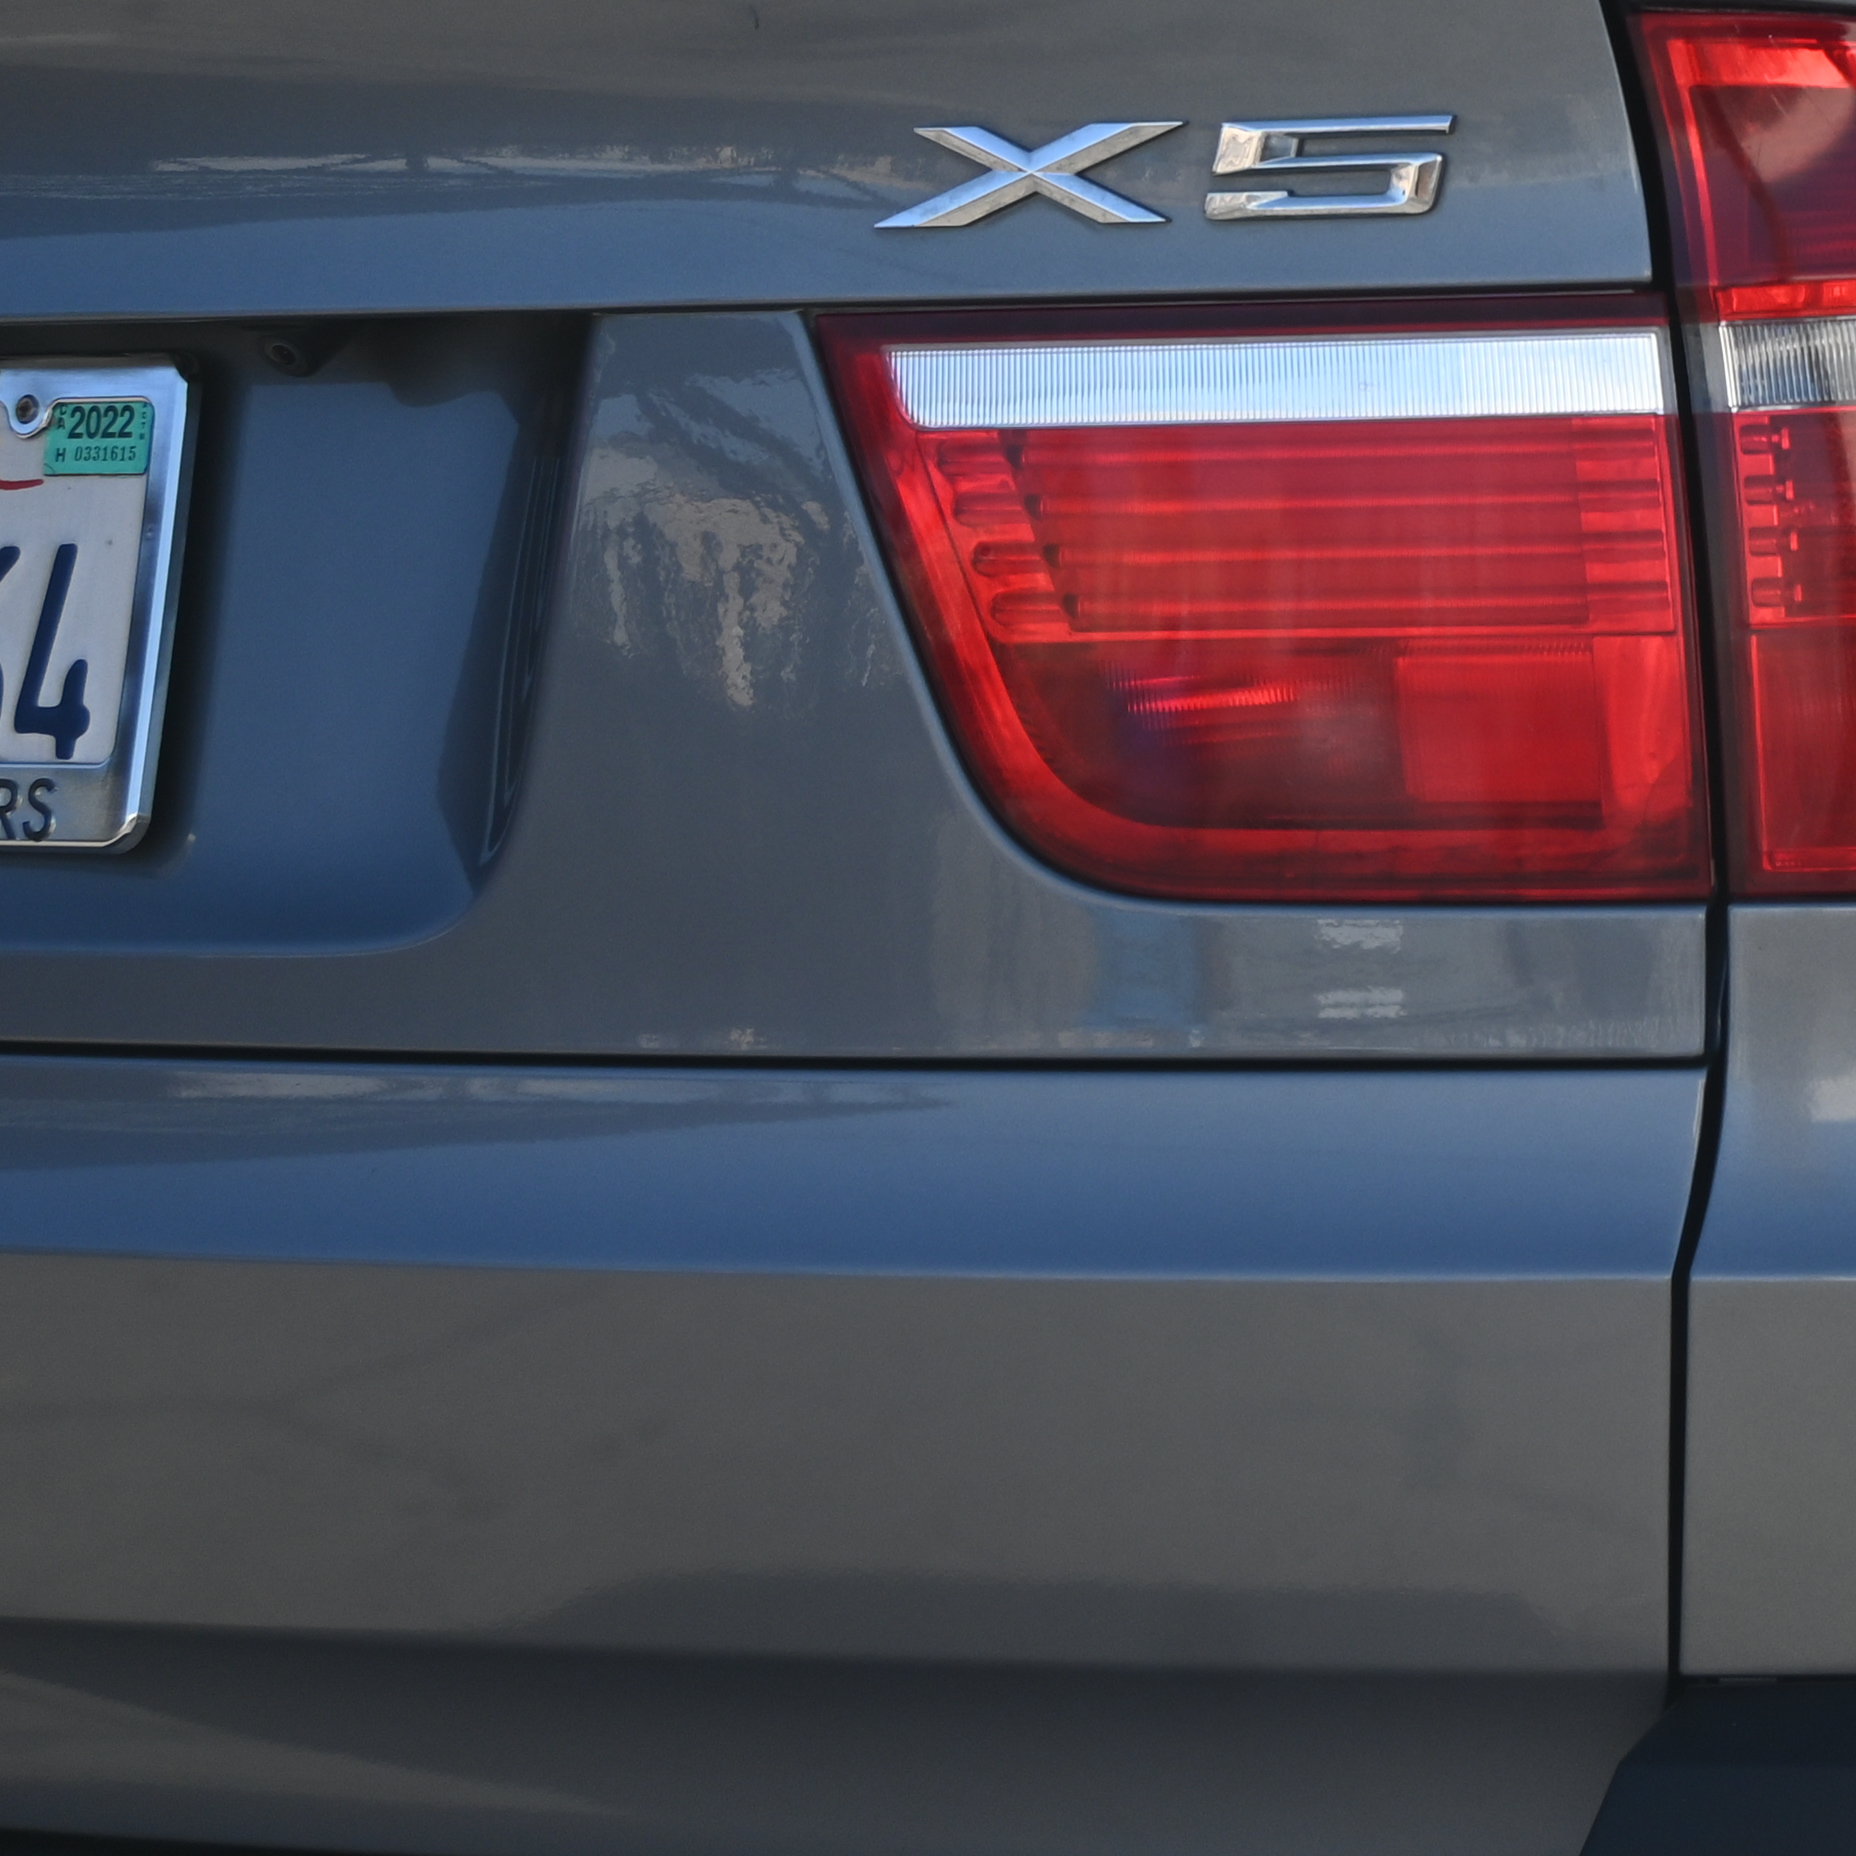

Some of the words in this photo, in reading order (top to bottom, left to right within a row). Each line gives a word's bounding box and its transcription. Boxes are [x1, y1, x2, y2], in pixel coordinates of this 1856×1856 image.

[873, 115, 1456, 228] X5
[55, 447, 66, 463] H
[74, 445, 136, 462] 0331615
[67, 404, 135, 440] 2022
[0, 543, 91, 760] 4
